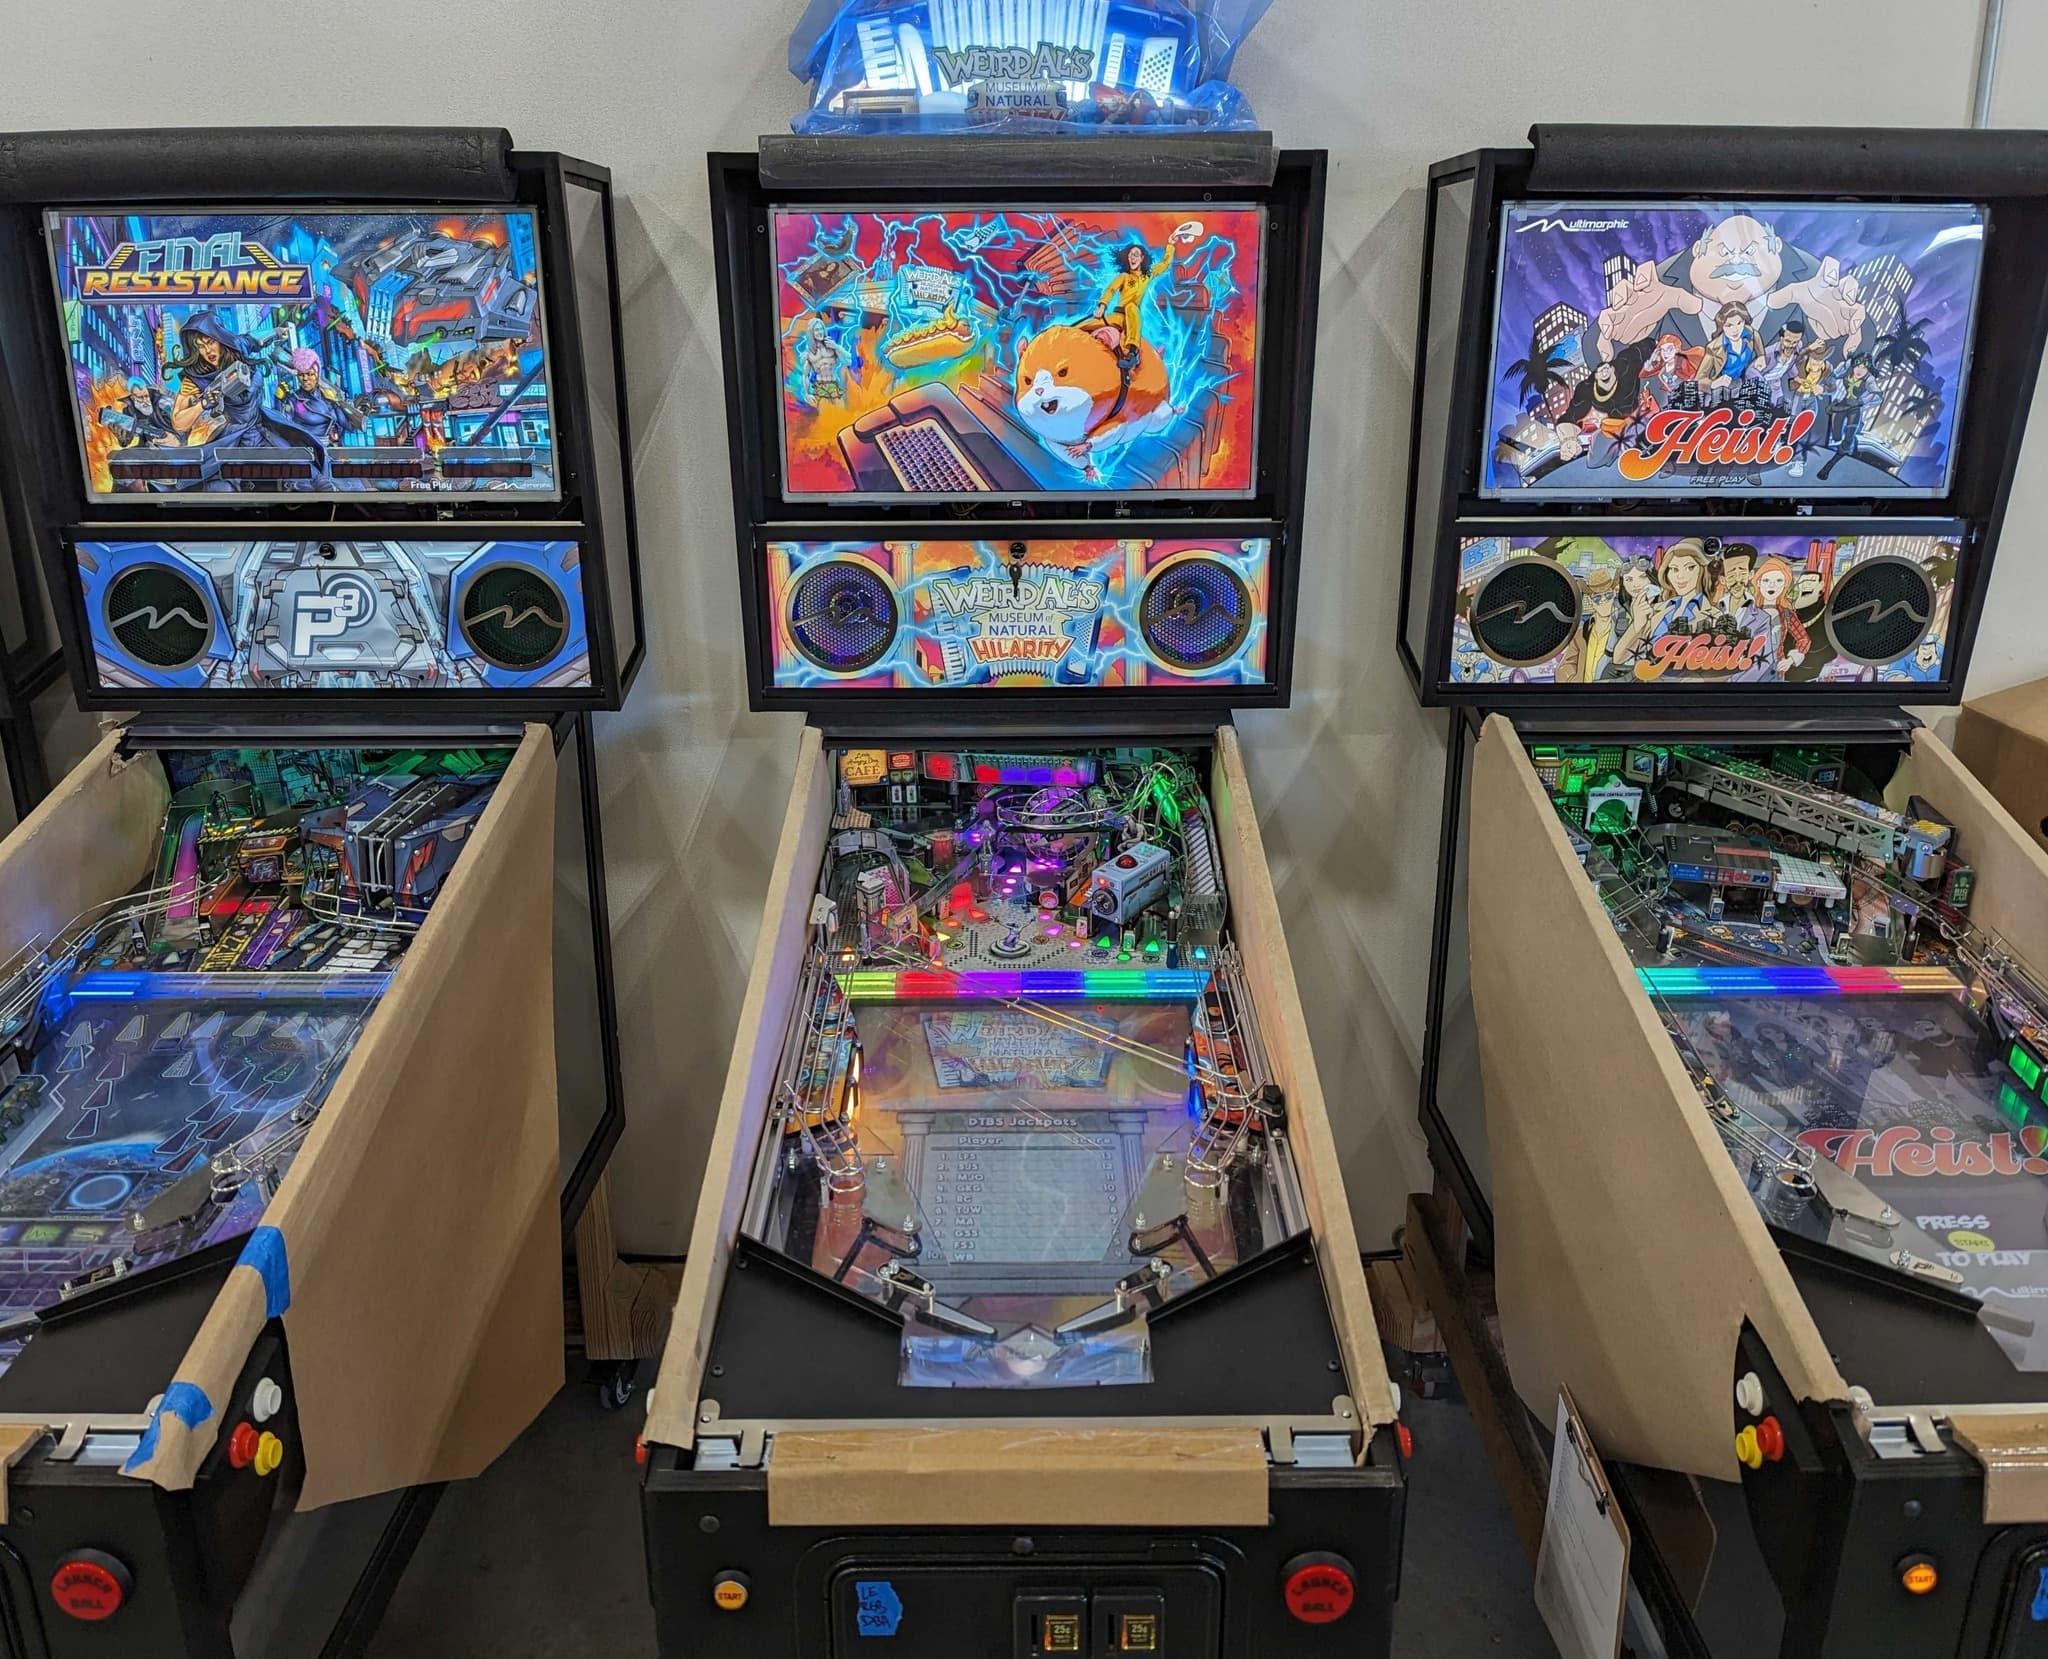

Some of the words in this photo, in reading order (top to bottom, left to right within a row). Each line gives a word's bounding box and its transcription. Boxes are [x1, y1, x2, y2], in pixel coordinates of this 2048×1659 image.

[934, 47, 1034, 87] WEIRD
[985, 82, 1037, 93] MUSEUM
[985, 95, 1050, 107] NATURAL
[134, 232, 256, 273] FINAL
[83, 271, 303, 295] RESISTANCE
[1618, 408, 1816, 481] Heist!
[410, 480, 431, 489] Free
[432, 480, 452, 490] Play
[1690, 475, 1715, 484] FREE
[1718, 475, 1745, 485] PLAY
[935, 579, 1037, 616] WEIRD
[1036, 576, 1101, 611] AL'S
[988, 612, 1043, 623] MUSEUM
[988, 624, 1056, 636] NATURAL
[971, 638, 1069, 660] HILARITY
[1635, 633, 1767, 681] Heist!
[967, 1117, 1003, 1127] DTBS
[1008, 1117, 1078, 1129] Jackpots
[958, 1136, 1002, 1145] Player
[1796, 1126, 2048, 1176] Heist!
[1916, 1214, 1990, 1230] PRESS
[1936, 1251, 1970, 1267] TO
[1976, 1251, 2032, 1267] PLAY
[718, 1592, 743, 1601] START
